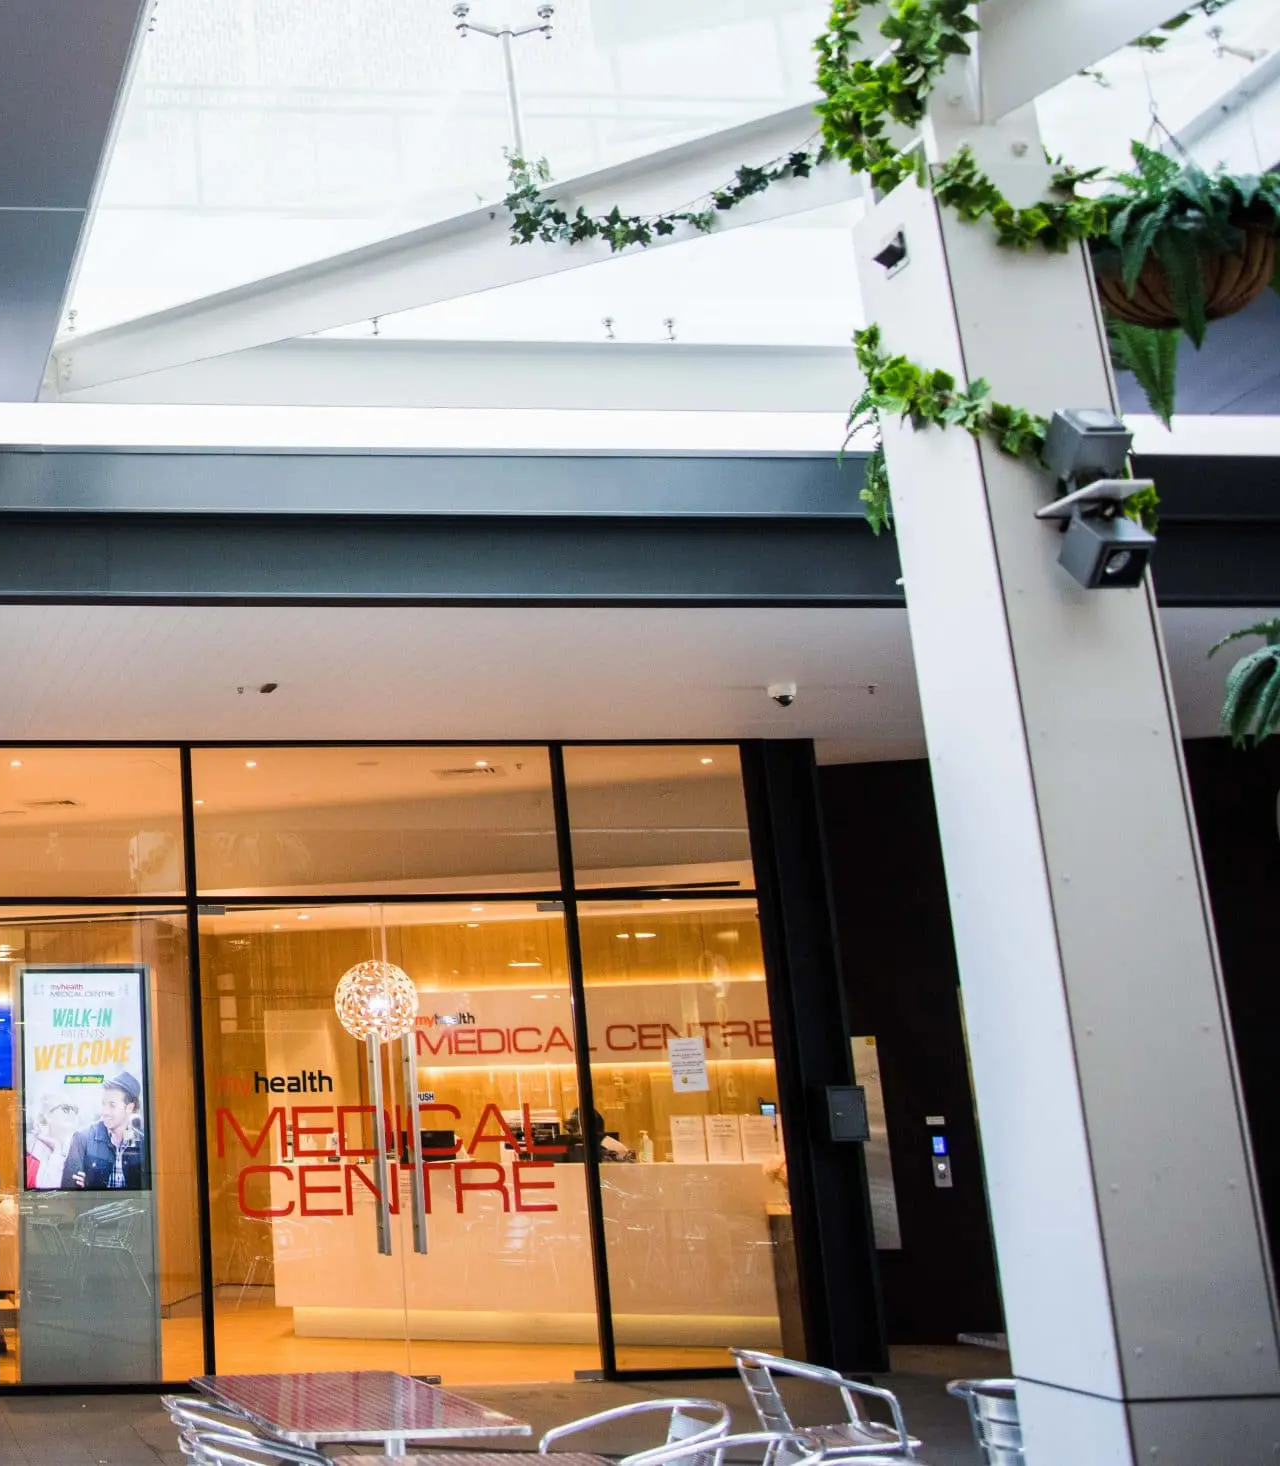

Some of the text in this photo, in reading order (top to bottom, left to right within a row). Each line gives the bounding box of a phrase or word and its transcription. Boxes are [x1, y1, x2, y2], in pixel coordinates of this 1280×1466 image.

[52, 1007, 113, 1028] WALK-IN
[33, 1036, 133, 1072] WELCOME
[415, 1026, 597, 1056] MEDICA
[215, 1103, 568, 1158] MEDICAL
[238, 1160, 558, 1217] CENTRE
